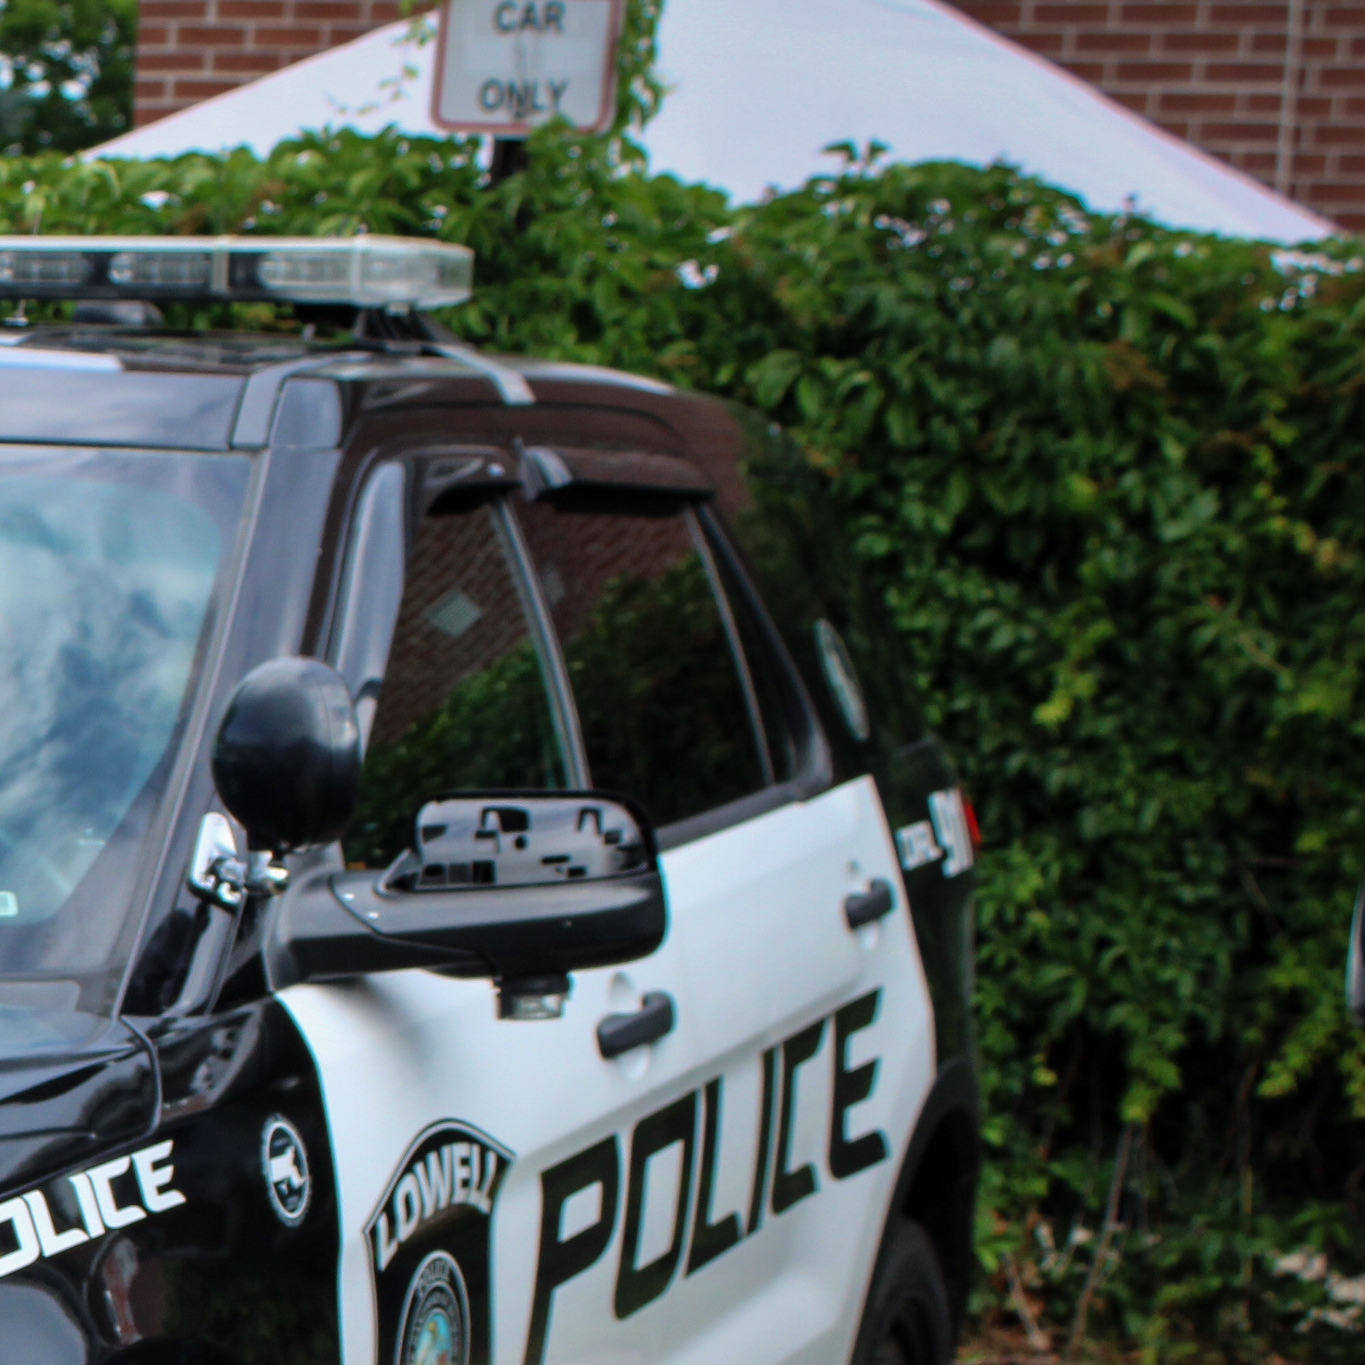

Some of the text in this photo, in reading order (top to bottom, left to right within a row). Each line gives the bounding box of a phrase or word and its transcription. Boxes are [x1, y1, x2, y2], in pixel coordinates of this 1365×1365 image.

[492, 0, 567, 34] CAR
[479, 77, 568, 114] ONLY
[375, 1141, 499, 1273] LOWELL
